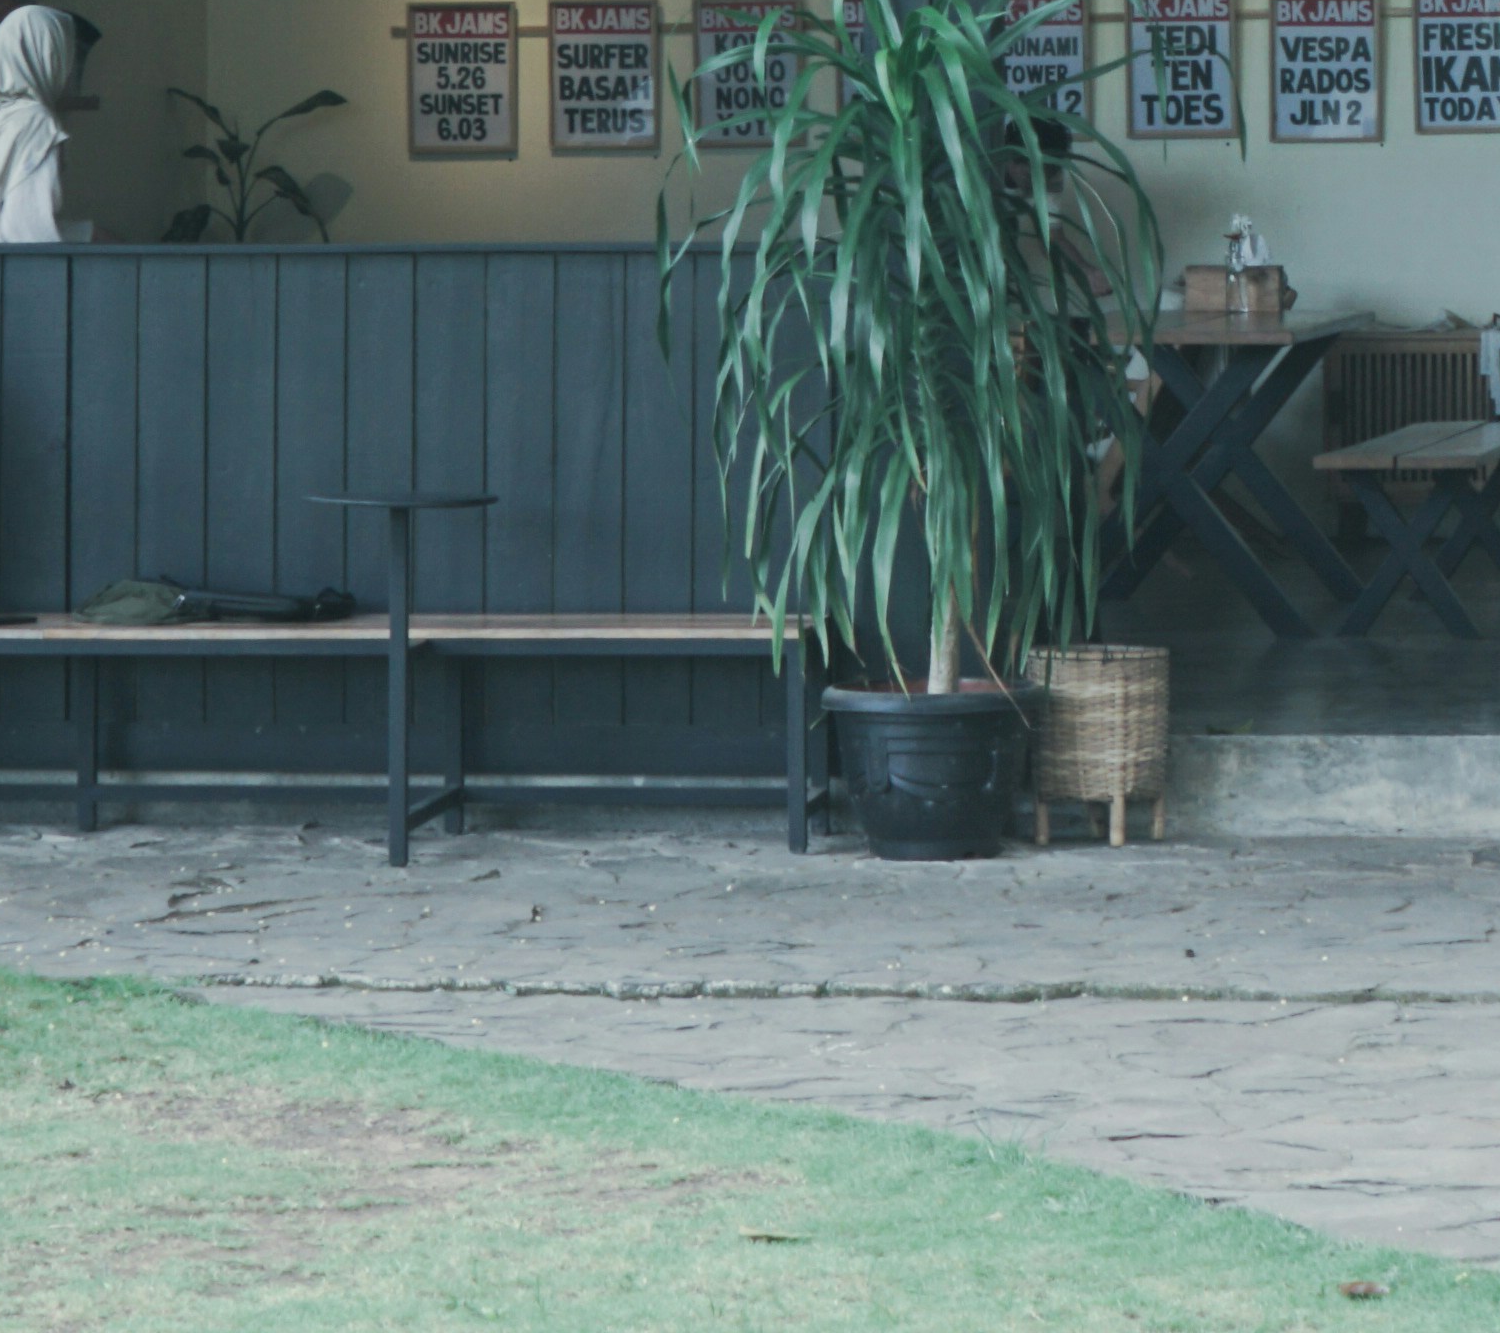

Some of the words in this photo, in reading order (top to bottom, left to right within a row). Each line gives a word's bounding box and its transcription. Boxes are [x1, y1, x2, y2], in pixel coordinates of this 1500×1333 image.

[414, 12, 443, 33] BK
[446, 12, 507, 34] JAMS
[556, 8, 584, 29] BK
[587, 8, 650, 29] JAMS
[1277, 0, 1305, 22] BK
[1309, 0, 1372, 22] JAMS
[417, 42, 506, 64] SUNRISE
[1146, 25, 1216, 56] TEDI
[1281, 37, 1371, 62] VESPA
[558, 44, 647, 69] SURFER
[437, 66, 485, 90] 5.26
[1151, 60, 1213, 90] TEN
[1281, 68, 1371, 94] RADOS
[559, 76, 650, 101] BASAH
[420, 94, 503, 115] SUNSET
[1141, 94, 1224, 125] TOES
[1290, 100, 1341, 125] JLN
[1346, 100, 1361, 125] 2
[438, 118, 487, 141] 6.03
[565, 108, 645, 133] TERUS
